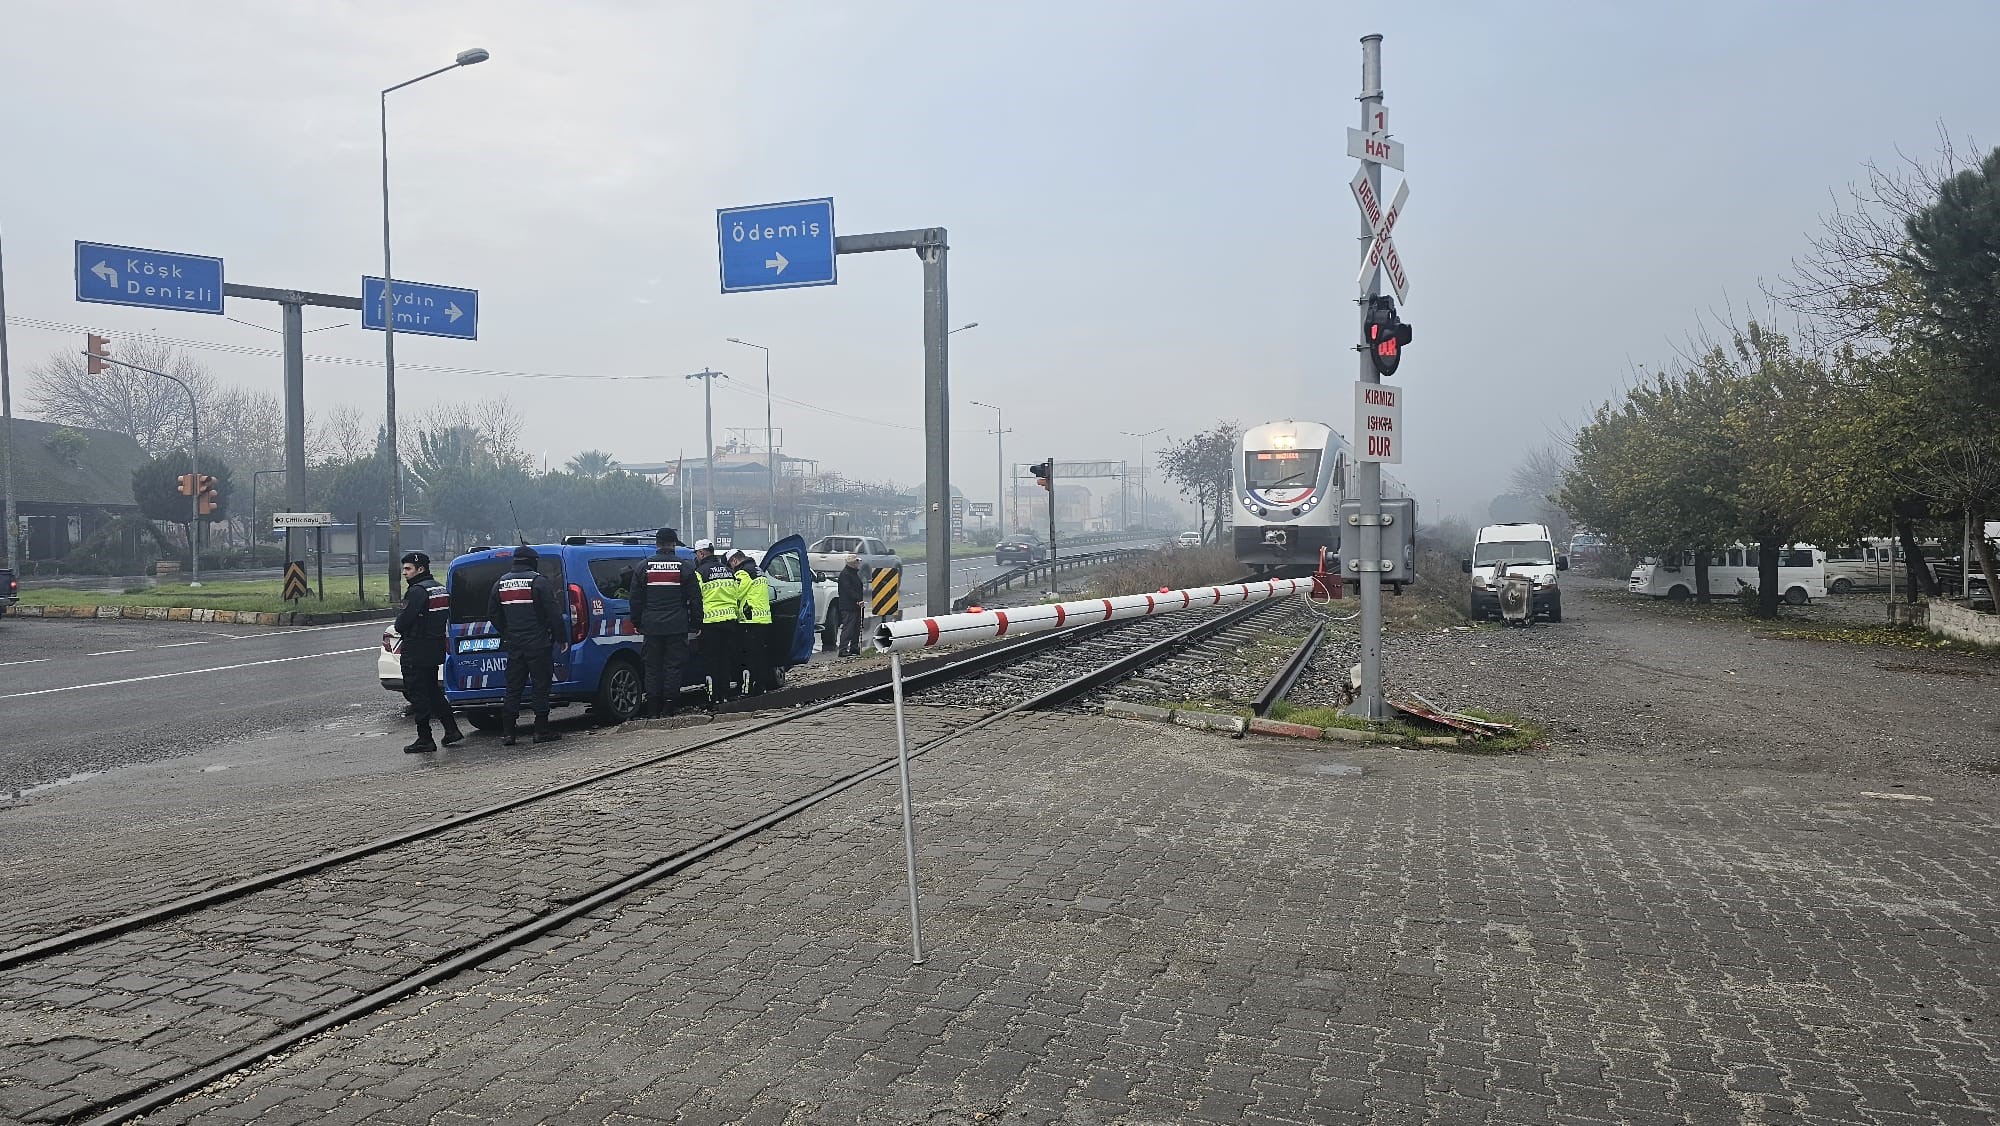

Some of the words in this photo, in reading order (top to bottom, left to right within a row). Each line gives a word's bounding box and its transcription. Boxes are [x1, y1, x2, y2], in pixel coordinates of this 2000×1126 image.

[1374, 111, 1384, 130] 1
[1365, 138, 1391, 160] HAT
[732, 220, 820, 243] Ödemiş
[127, 258, 182, 279] Köşk
[1386, 242, 1405, 290] YOLU
[127, 280, 212, 302] Denizli
[377, 304, 431, 325] İmir
[1378, 336, 1397, 356] DUR
[1365, 388, 1395, 408] KIRMIZI
[1368, 435, 1391, 457] DUR
[480, 657, 508, 673] JAND
